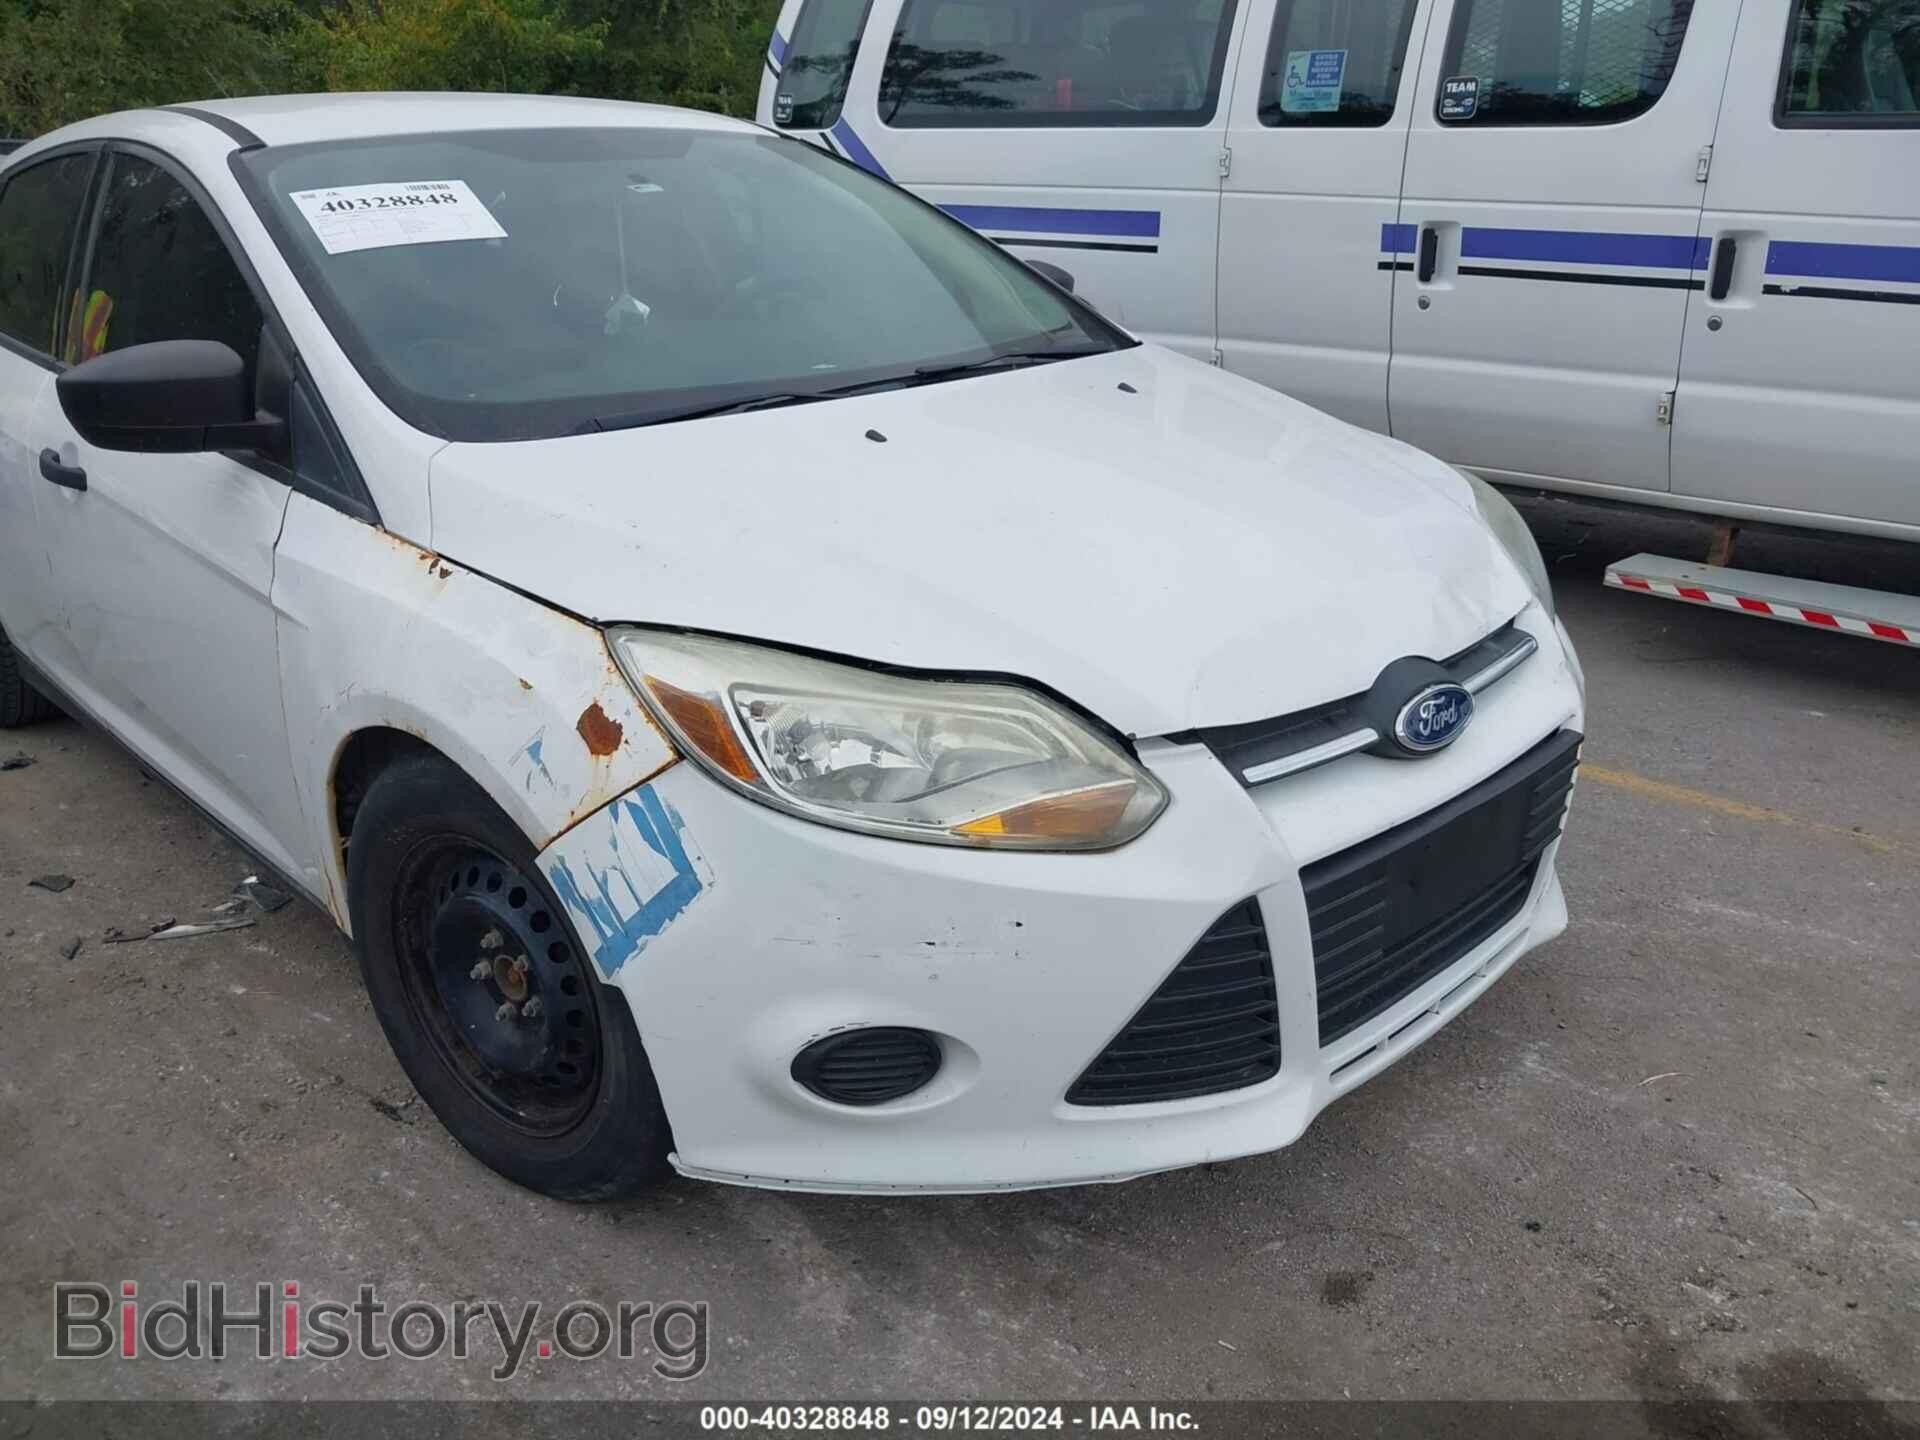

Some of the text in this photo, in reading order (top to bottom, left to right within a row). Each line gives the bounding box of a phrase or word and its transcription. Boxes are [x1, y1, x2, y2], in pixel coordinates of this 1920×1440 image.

[1446, 81, 1476, 93] TEAM
[320, 192, 458, 212] 40328848
[1419, 695, 1458, 736] Ford
